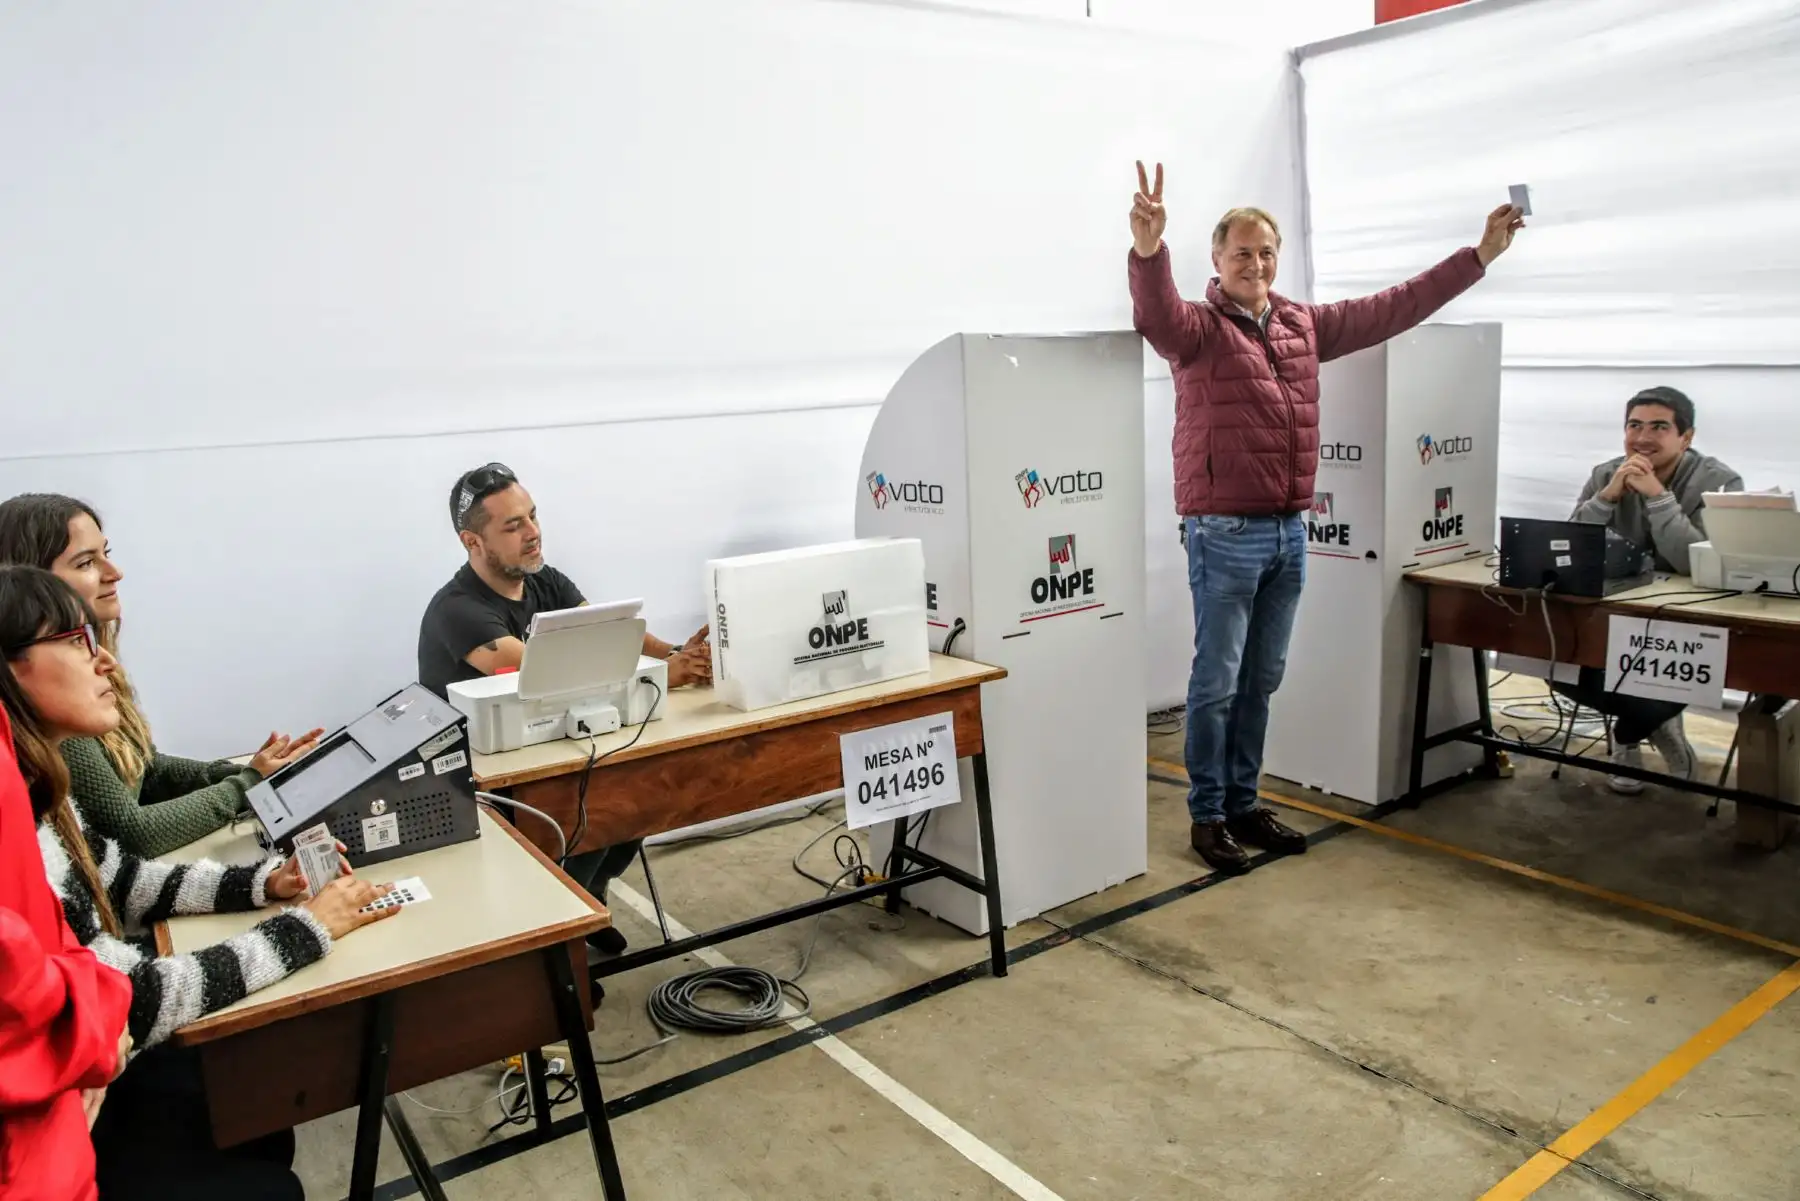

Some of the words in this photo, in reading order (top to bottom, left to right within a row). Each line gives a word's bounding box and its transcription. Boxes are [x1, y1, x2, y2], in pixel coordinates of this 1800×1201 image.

[1320, 442, 1361, 461] oto
[1434, 436, 1472, 456] voto
[889, 480, 943, 504] voto
[1043, 470, 1102, 496] voto
[1307, 520, 1350, 546] NPE
[1423, 514, 1463, 541] ONPE
[1030, 568, 1094, 604] ONPE
[718, 603, 729, 649] ONPE
[808, 617, 869, 649] ONPE
[1630, 634, 1678, 653] MESA
[1620, 654, 1711, 684] 041495
[864, 747, 913, 771] MESA
[858, 763, 945, 805] 041496
